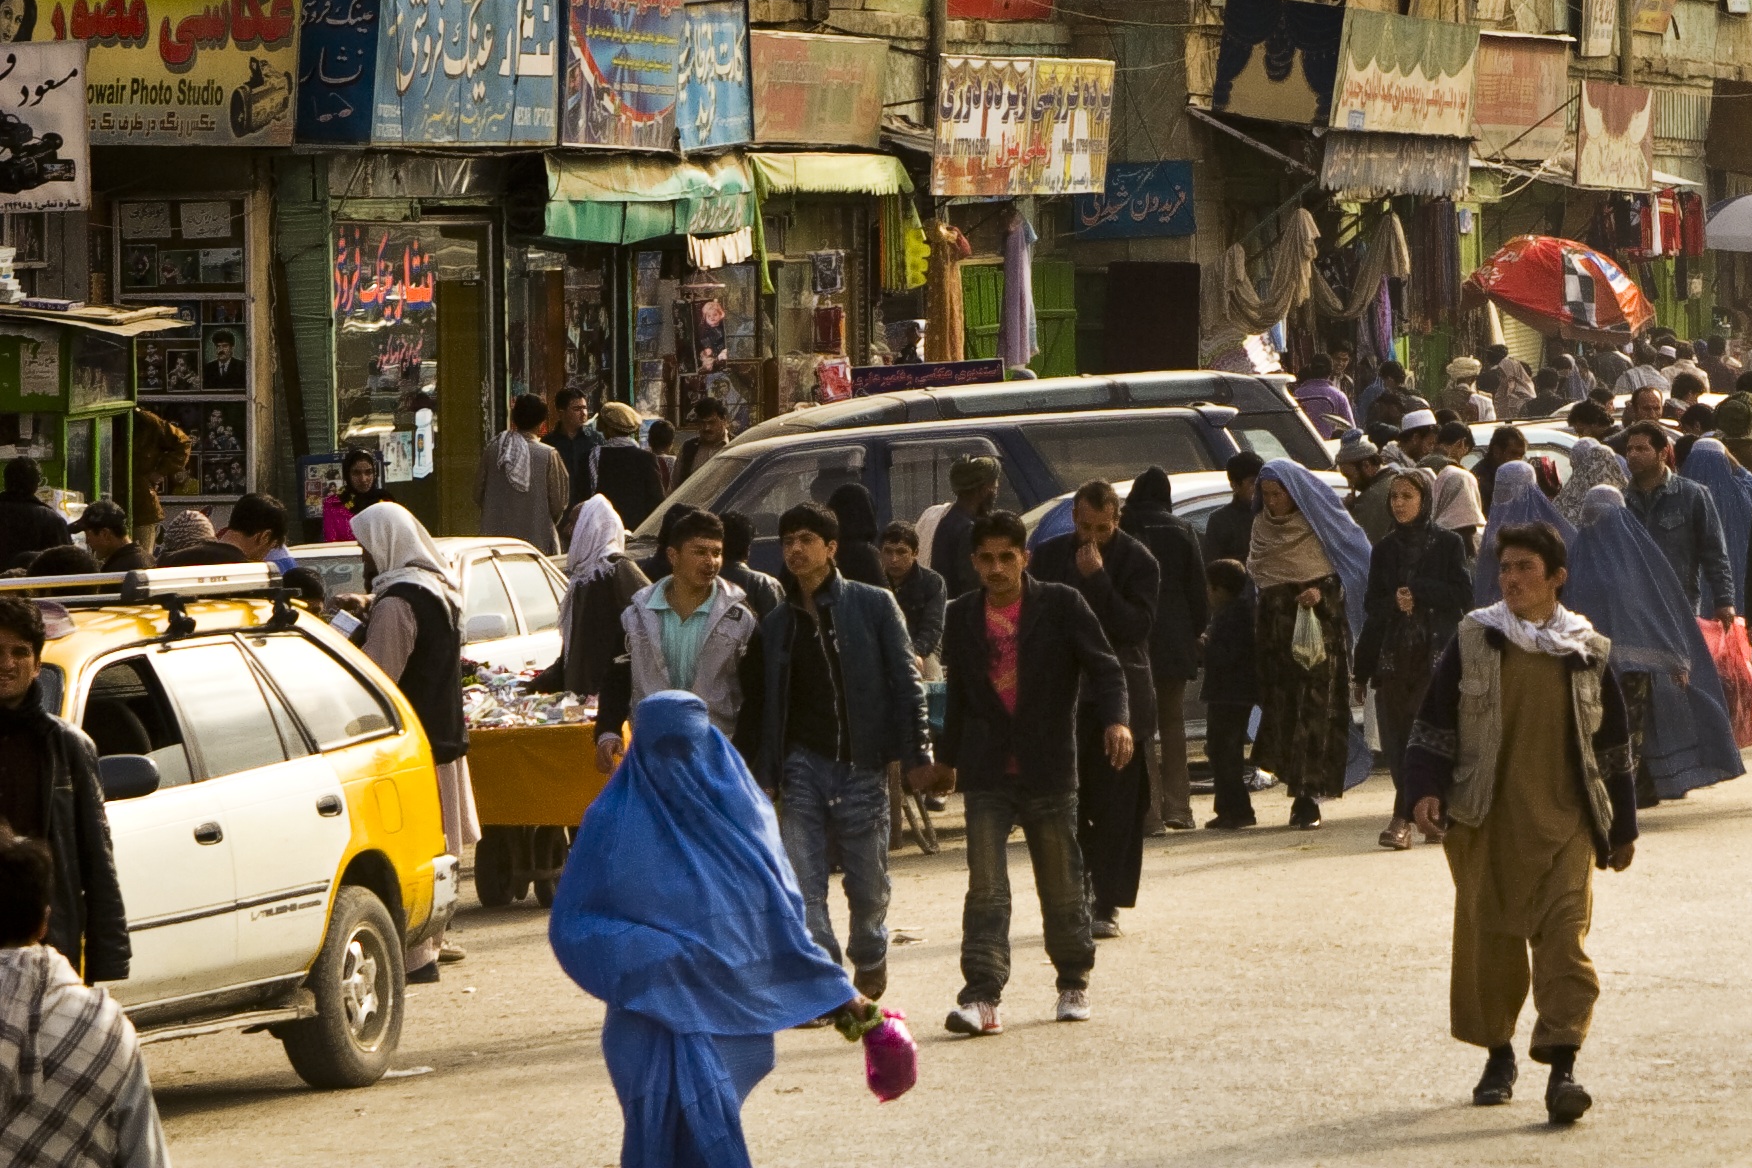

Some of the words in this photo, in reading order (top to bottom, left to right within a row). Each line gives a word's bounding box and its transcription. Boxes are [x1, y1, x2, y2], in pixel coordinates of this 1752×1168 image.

[18, 68, 79, 107] مسعود
[86, 78, 127, 105] owair
[130, 77, 173, 105] Photo
[177, 78, 224, 106] Studio
[118, 112, 143, 137] ظرف
[145, 118, 156, 137] در
[186, 114, 216, 137] عکس
